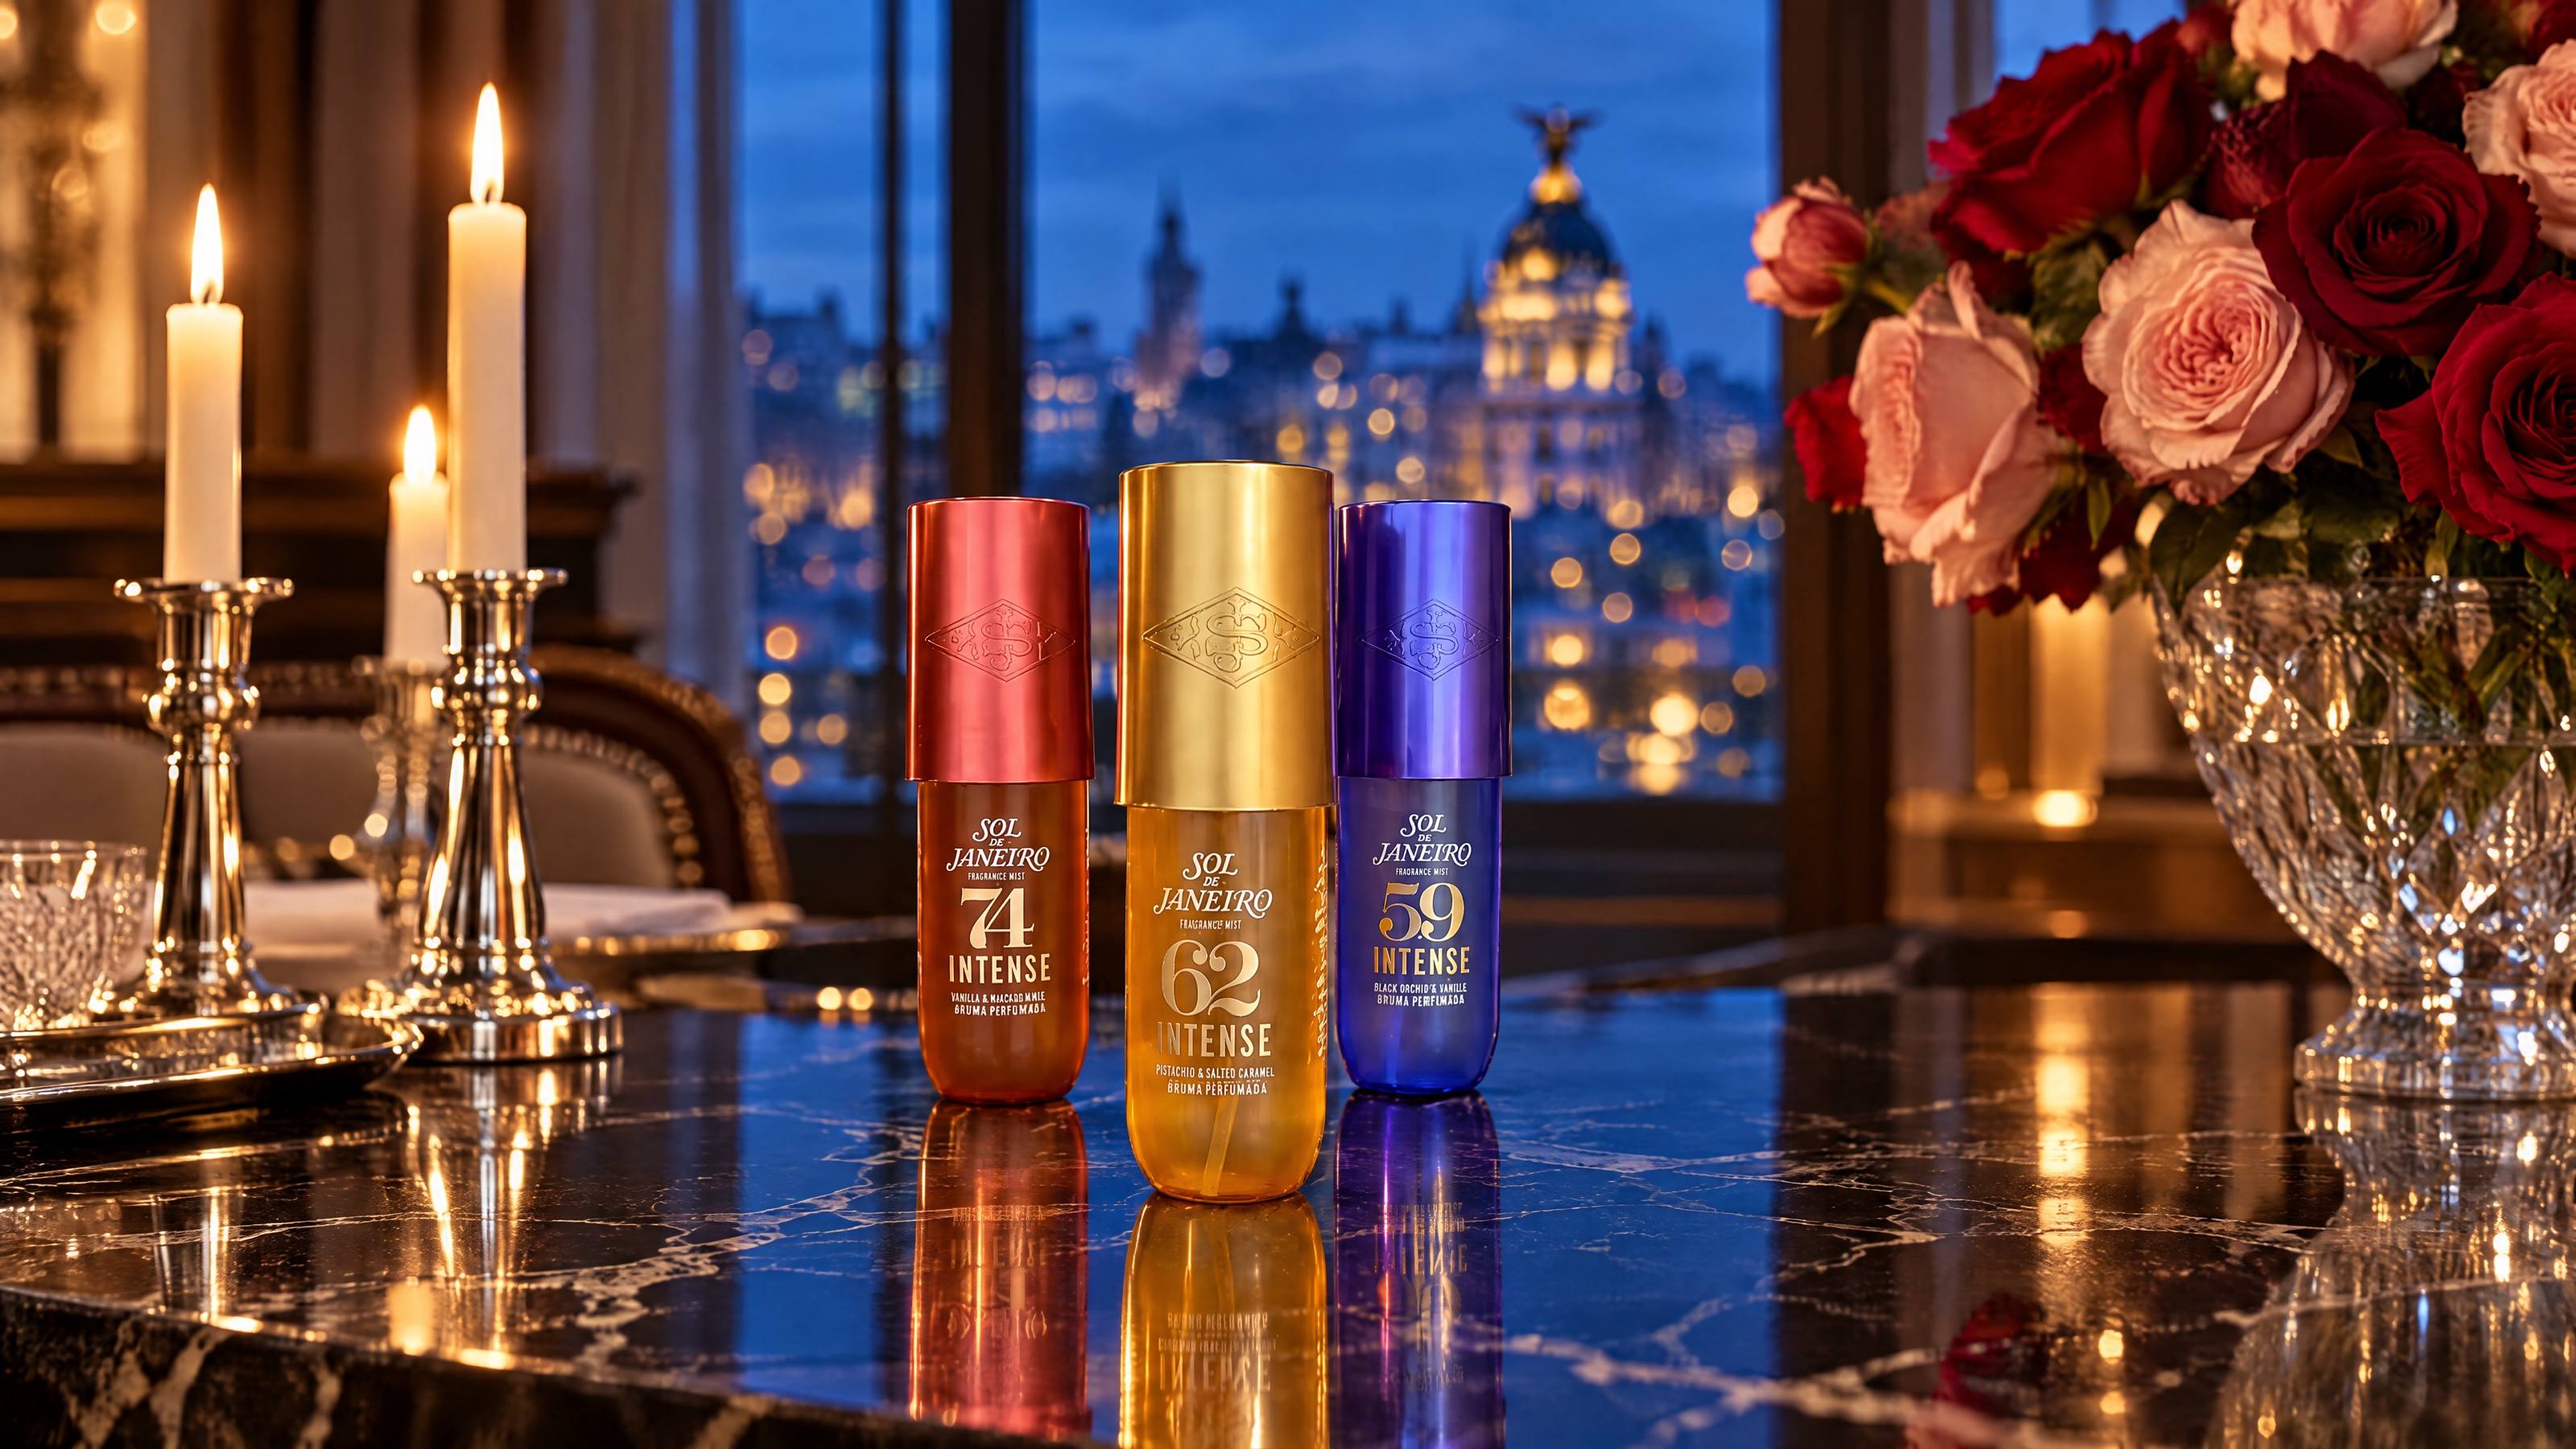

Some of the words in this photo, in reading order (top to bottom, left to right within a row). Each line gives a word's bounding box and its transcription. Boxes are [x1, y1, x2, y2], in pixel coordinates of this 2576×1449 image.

[972, 818, 1022, 842] SOL
[1400, 814, 1447, 837] SOL
[989, 839, 1004, 847] DE
[1418, 834, 1432, 842] DE
[946, 847, 1051, 872] JANEIRO
[1183, 852, 1238, 880] SOL
[1373, 842, 1472, 867] JANEIRO
[1009, 872, 1025, 881] MIST
[1203, 877, 1219, 886] DE
[1433, 868, 1448, 876] MIST
[1154, 887, 1273, 919] JANEIRO
[960, 887, 1035, 949] 74
[1225, 919, 1242, 930] MIST
[949, 953, 1051, 984] INTENSE
[1373, 947, 1470, 976] INTENSE
[1162, 939, 1261, 1017] 62
[1374, 982, 1397, 993] BLACK
[1377, 994, 1409, 1007] BRUMA
[1158, 1022, 1271, 1057] INTENSE
[1156, 1064, 1195, 1078] PISTACHIO
[1198, 1068, 1203, 1079] &
[1238, 1067, 1274, 1079] CARAMEL
[1167, 1082, 1202, 1096] BRUMA
[1205, 1082, 1267, 1096] PERFUMADA
